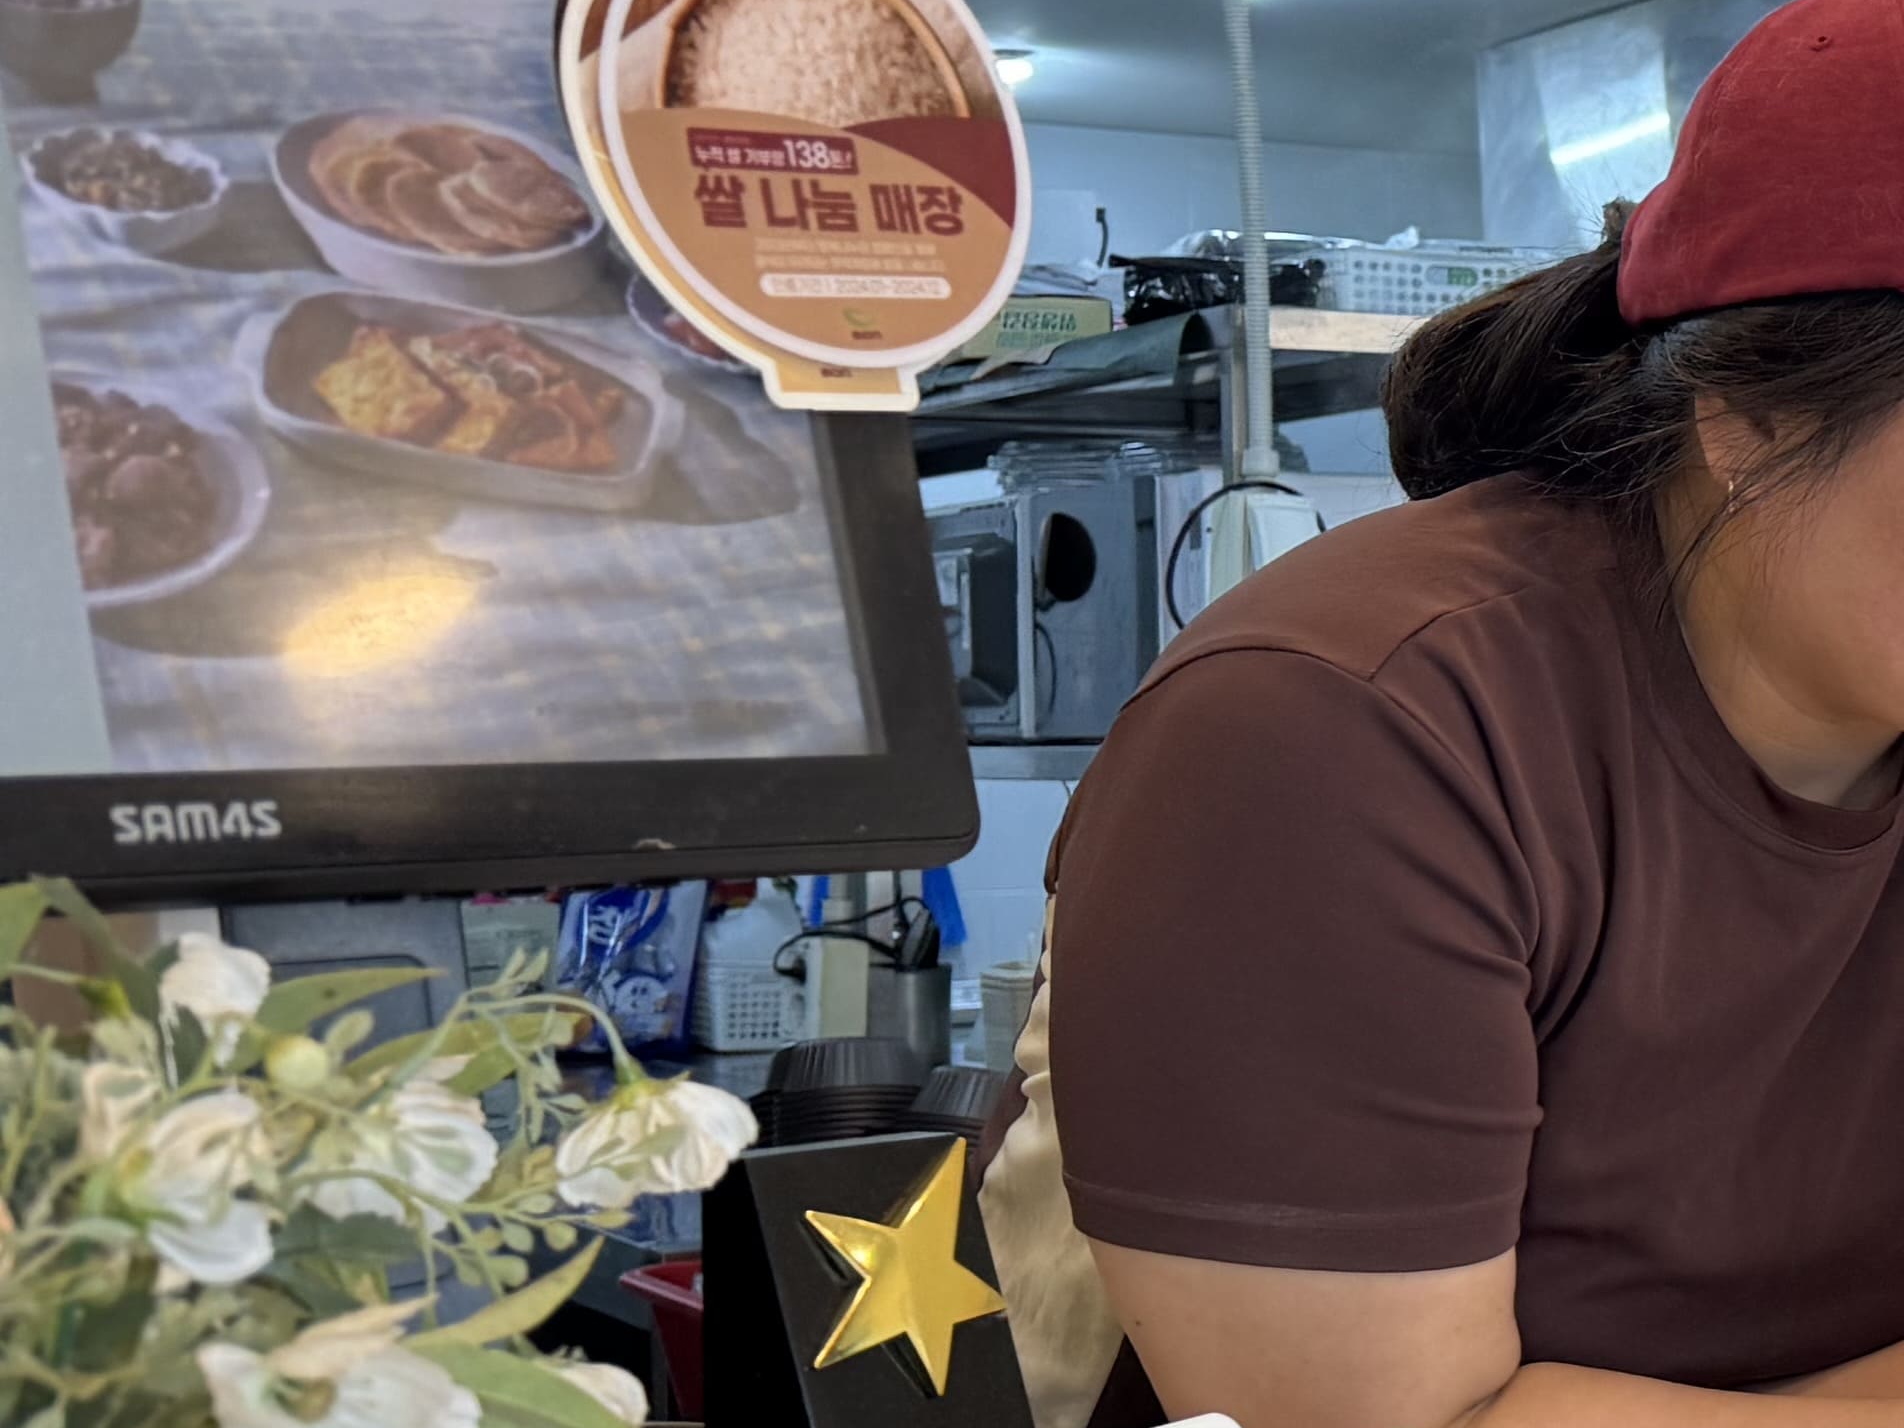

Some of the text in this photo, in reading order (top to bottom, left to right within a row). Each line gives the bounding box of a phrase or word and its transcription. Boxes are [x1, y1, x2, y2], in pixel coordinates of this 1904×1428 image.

[694, 174, 964, 237] 쌀 나눔 매장
